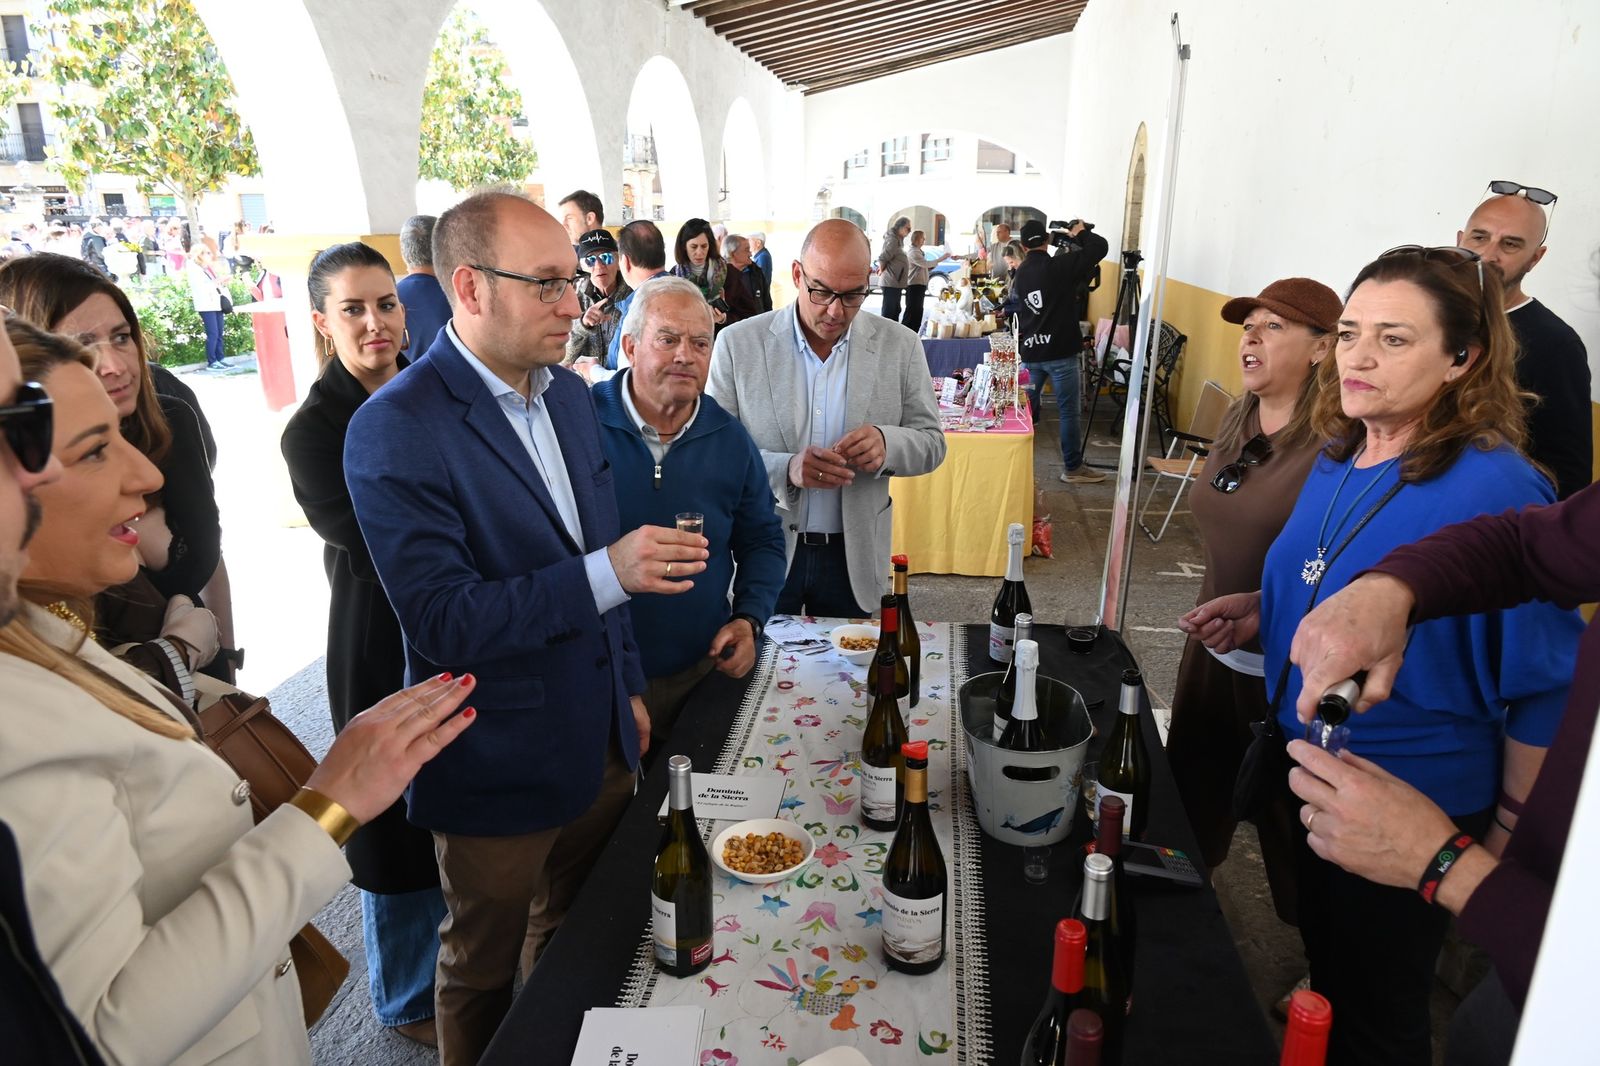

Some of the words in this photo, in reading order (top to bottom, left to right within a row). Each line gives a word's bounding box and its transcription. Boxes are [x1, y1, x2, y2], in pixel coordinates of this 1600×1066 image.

[1024, 333, 1051, 348] cyltv
[706, 787, 744, 795] Dominio
[919, 906, 940, 916] Sierra
[611, 1047, 623, 1058] de
